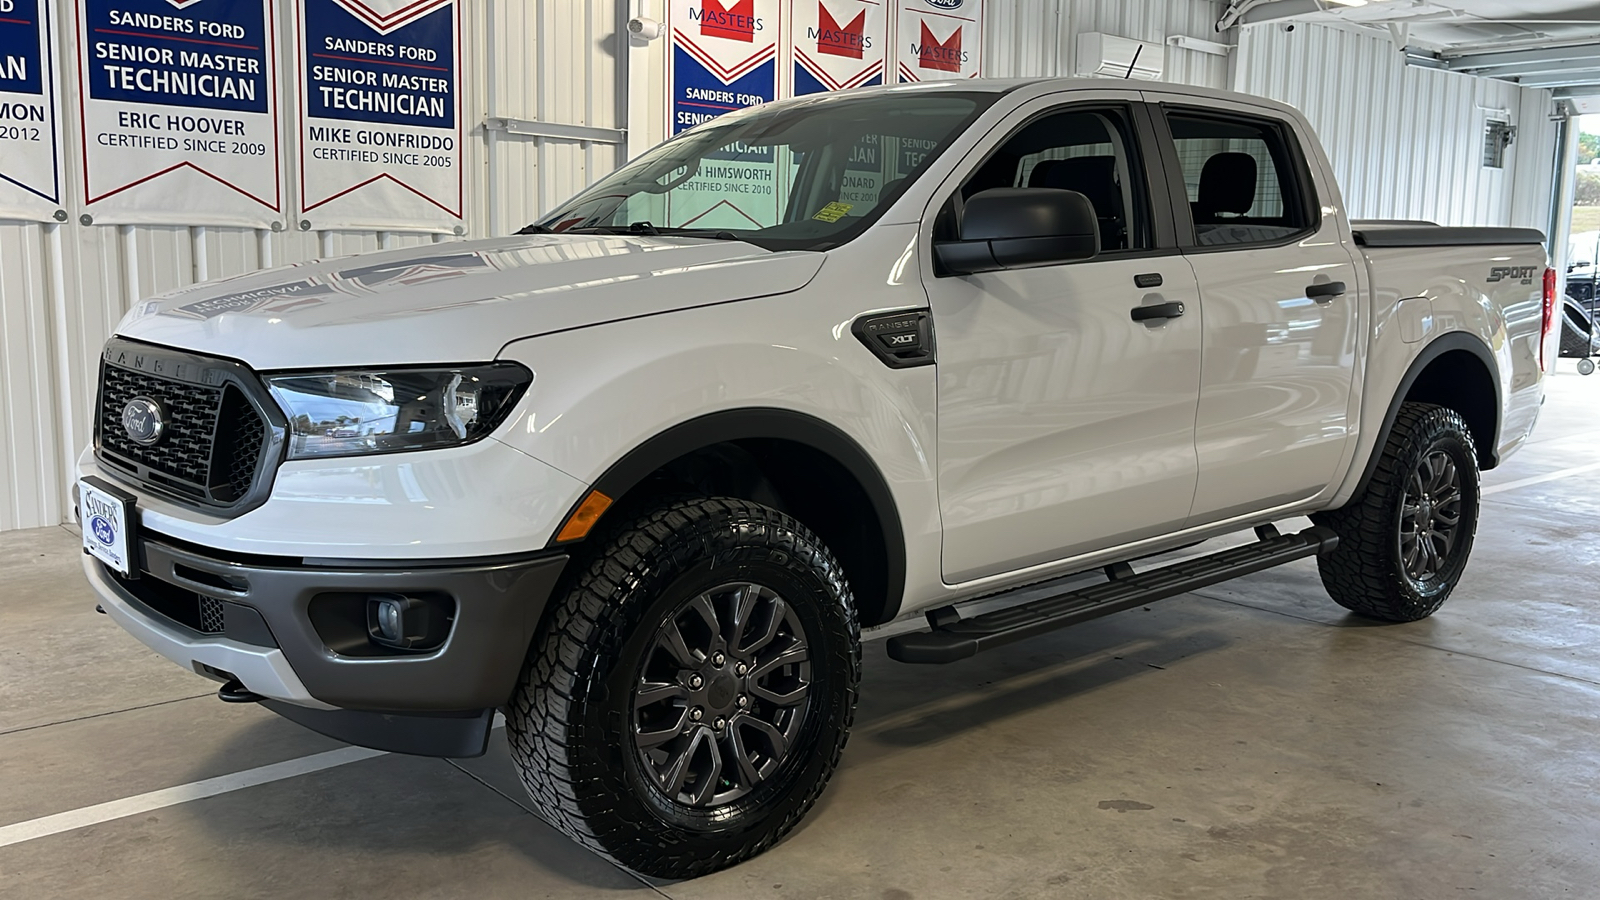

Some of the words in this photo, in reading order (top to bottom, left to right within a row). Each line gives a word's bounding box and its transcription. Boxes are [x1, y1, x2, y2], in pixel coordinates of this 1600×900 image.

[109, 10, 194, 33] SANDERS
[199, 21, 245, 39] FORD
[689, 7, 764, 31] MASTERS
[807, 27, 872, 48] MASTERS
[95, 42, 174, 65] SENIOR
[180, 51, 260, 74] MASTER
[325, 37, 395, 57] SANDERS
[399, 46, 437, 62] FORD
[910, 43, 968, 62] MASTERS
[104, 65, 255, 101] TECHNICIAN
[313, 66, 377, 86] SENIOR
[382, 73, 449, 93] MASTER
[320, 86, 444, 118] TECHNICIAN
[686, 87, 734, 104] SANDERS
[737, 93, 764, 105] FORD
[118, 112, 161, 130] ERIC
[167, 115, 245, 136] HOOVER
[677, 111, 717, 125] SENIO
[0, 126, 40, 141] 2012
[97, 133, 178, 150] CERTIFIED
[184, 139, 226, 153] SINCE
[231, 142, 266, 155] 2009
[309, 126, 351, 144] MIKE
[357, 130, 454, 150] GIONFRIDDO
[313, 147, 379, 162] CERTIFIED
[382, 152, 419, 165] SINCE
[423, 155, 452, 167] 2005
[677, 165, 702, 178] DN
[705, 166, 772, 181] HIMSWORTH
[677, 181, 722, 192] CERTIFIED
[724, 182, 749, 193] SINCE
[752, 184, 772, 195] 2010
[840, 191, 858, 202] INCE
[1486, 266, 1537, 283] SPORT
[869, 320, 917, 331] RANGER
[891, 334, 916, 345] XLT
[125, 405, 146, 434] Ford
[86, 490, 119, 533] SANDERS
[95, 518, 111, 543] Ford
